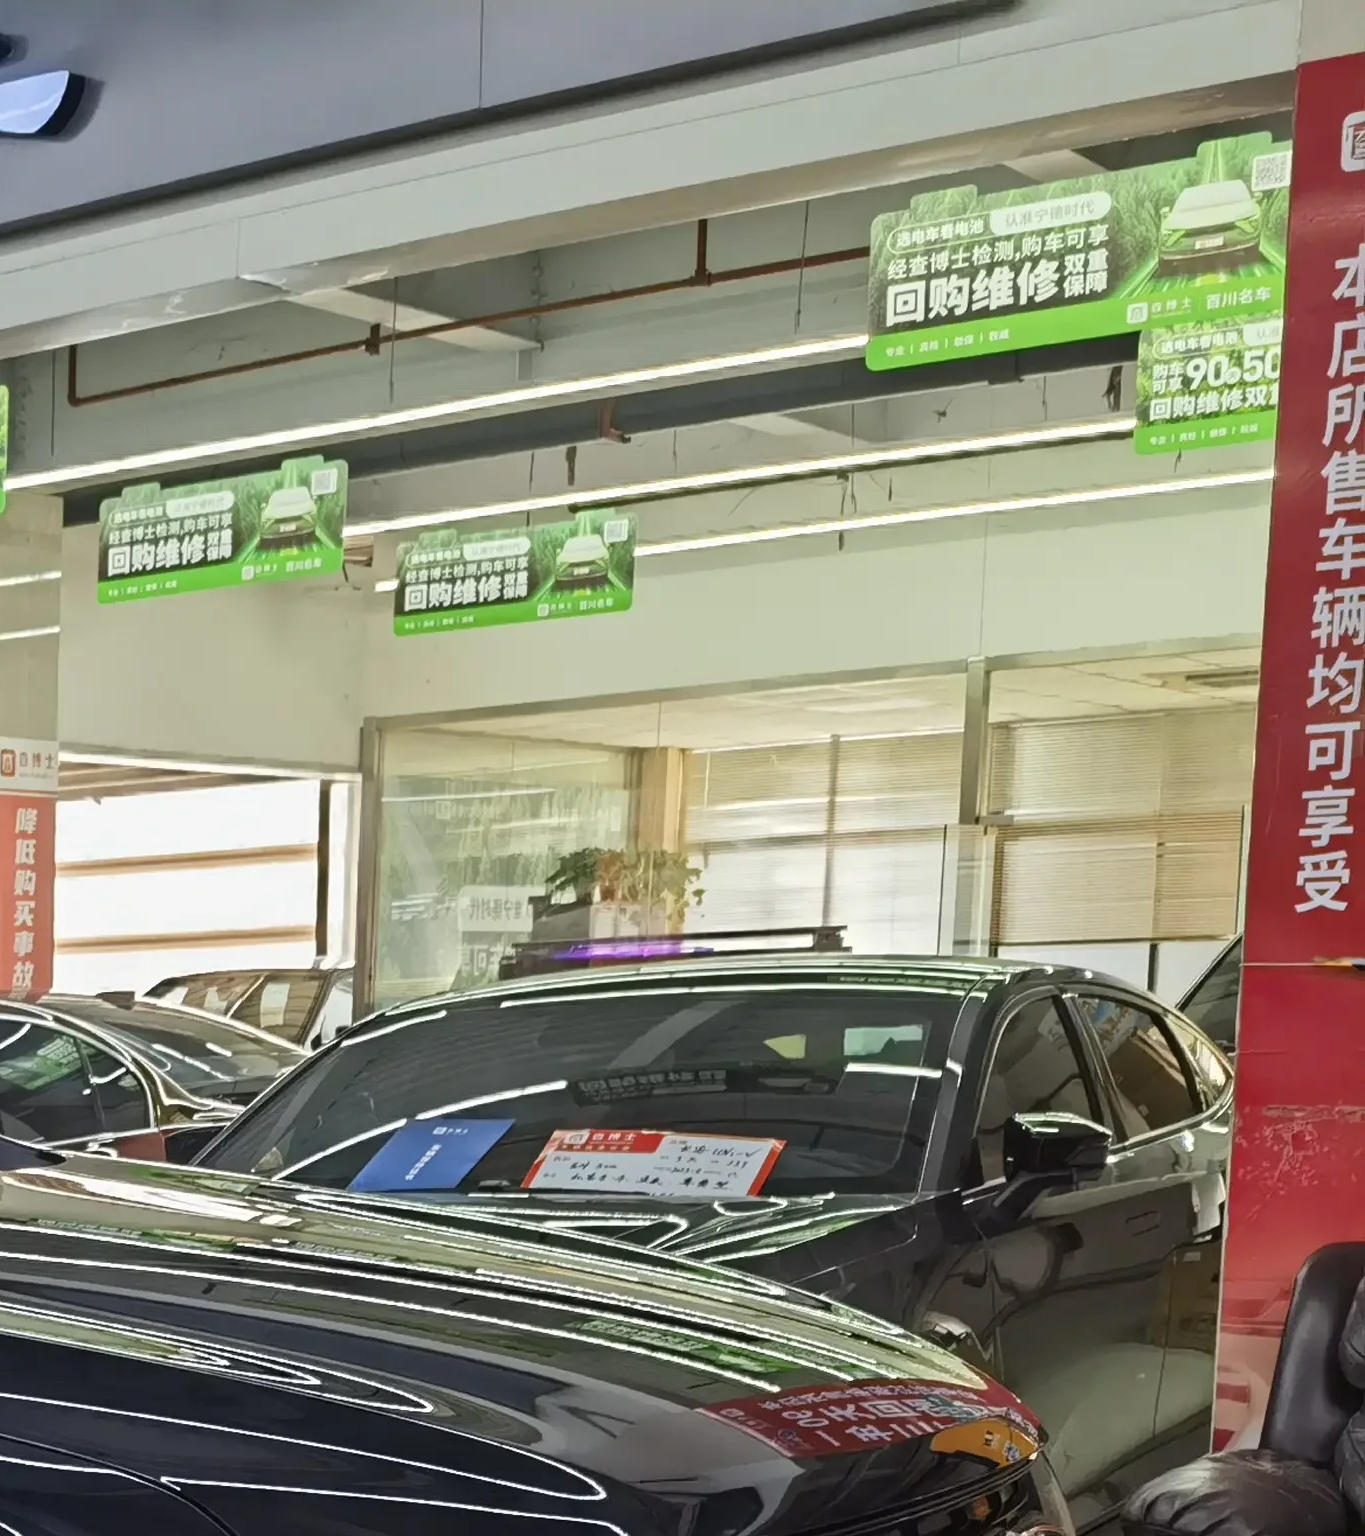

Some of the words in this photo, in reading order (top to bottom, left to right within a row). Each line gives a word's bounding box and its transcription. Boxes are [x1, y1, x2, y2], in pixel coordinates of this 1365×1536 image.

[896, 220, 984, 248] 选电车看电池
[1064, 248, 1109, 276] 双重
[885, 259, 1060, 327] 回购维修
[1063, 270, 1108, 298] 保障
[1206, 287, 1271, 309] 百川名车
[107, 533, 206, 577] 回购维修
[403, 576, 502, 612] 回购维修
[1294, 243, 1365, 912] 本店所售车辆均可享受
[12, 807, 39, 988] 降低购买事故
